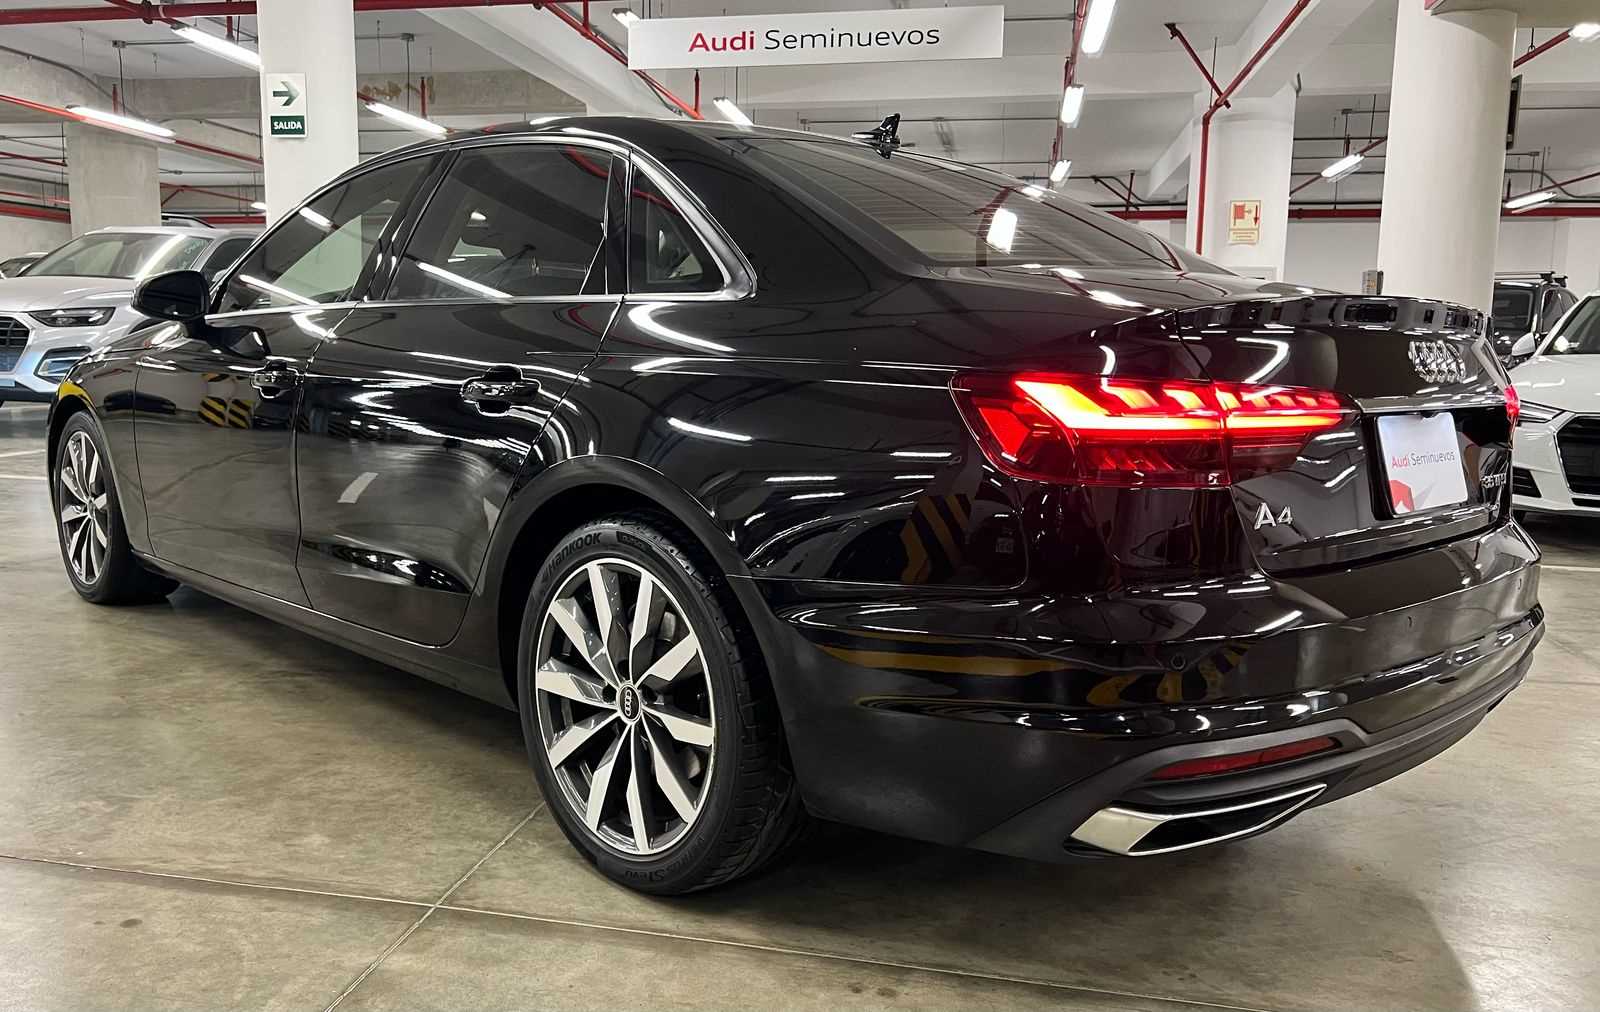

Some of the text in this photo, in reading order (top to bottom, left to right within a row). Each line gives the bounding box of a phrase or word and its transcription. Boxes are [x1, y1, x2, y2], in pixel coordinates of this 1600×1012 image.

[688, 28, 940, 52] Audi Seminuevos
[273, 121, 303, 130] SALIDA
[1391, 451, 1456, 469] Audi Seminuevos
[1254, 501, 1293, 531] A4
